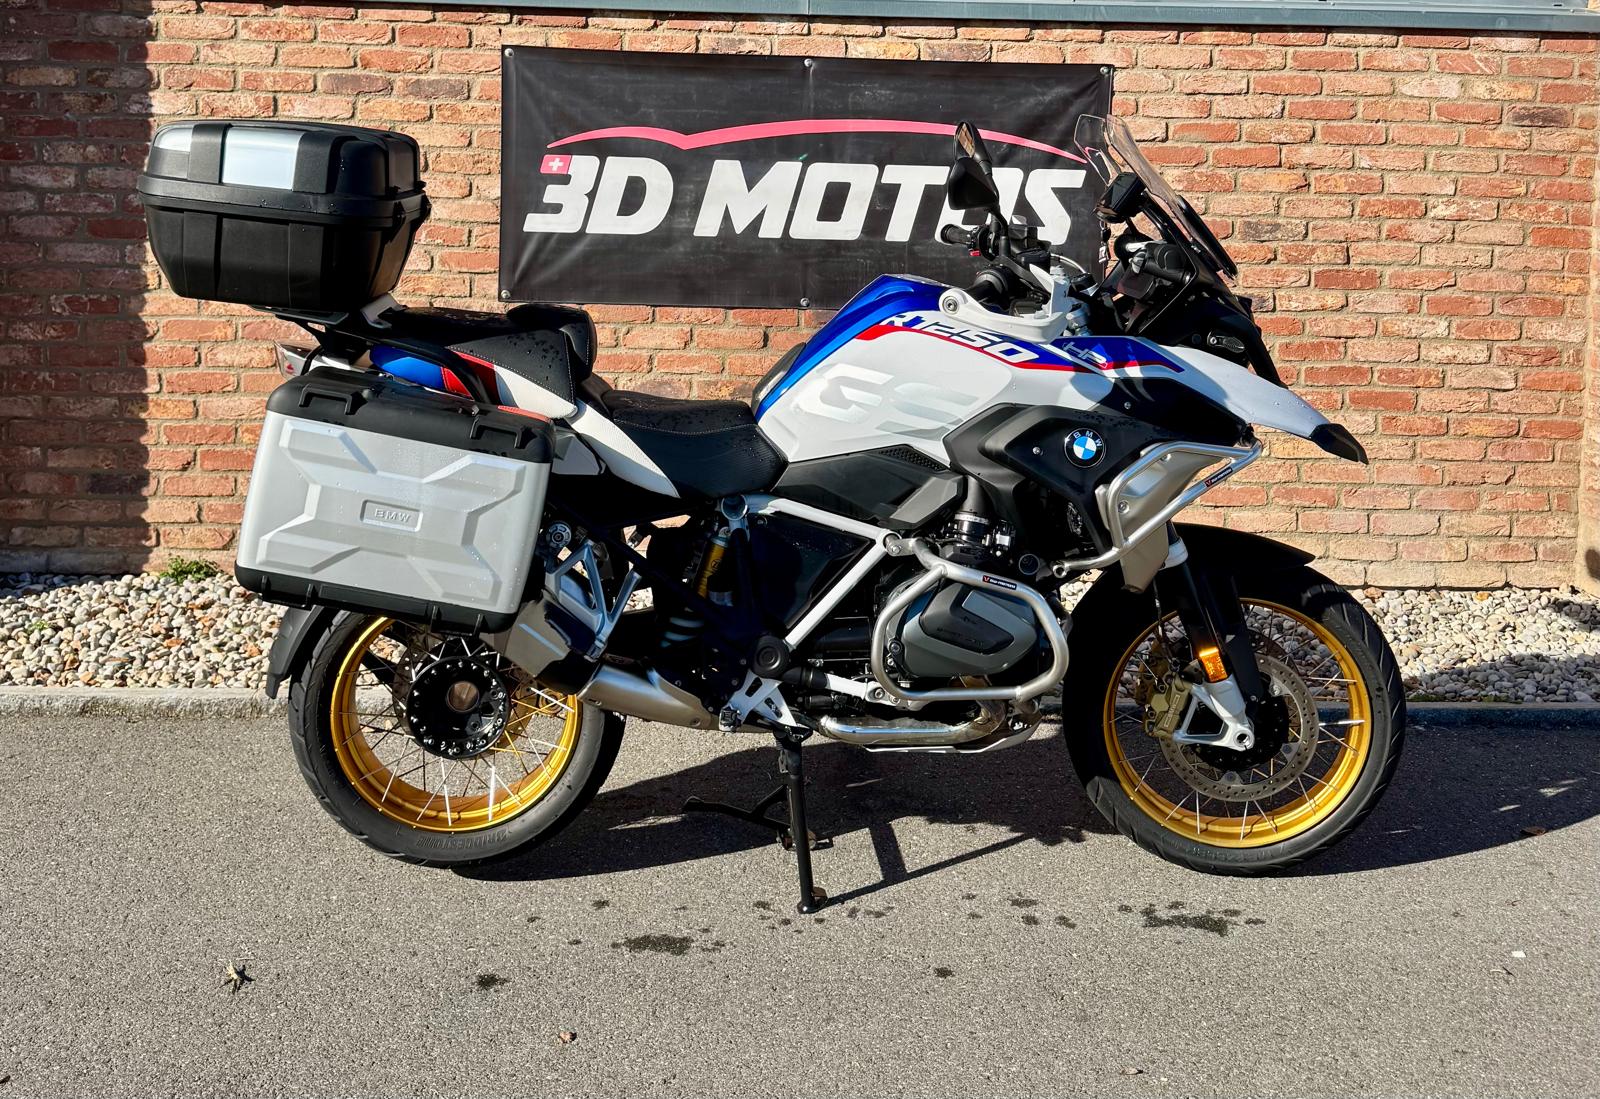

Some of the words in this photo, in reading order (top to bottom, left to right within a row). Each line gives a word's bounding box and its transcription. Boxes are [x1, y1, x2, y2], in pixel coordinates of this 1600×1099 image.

[523, 154, 674, 236] 3D
[1062, 341, 1107, 368] HP
[1073, 430, 1103, 447] BMW
[374, 508, 411, 523] BMW
